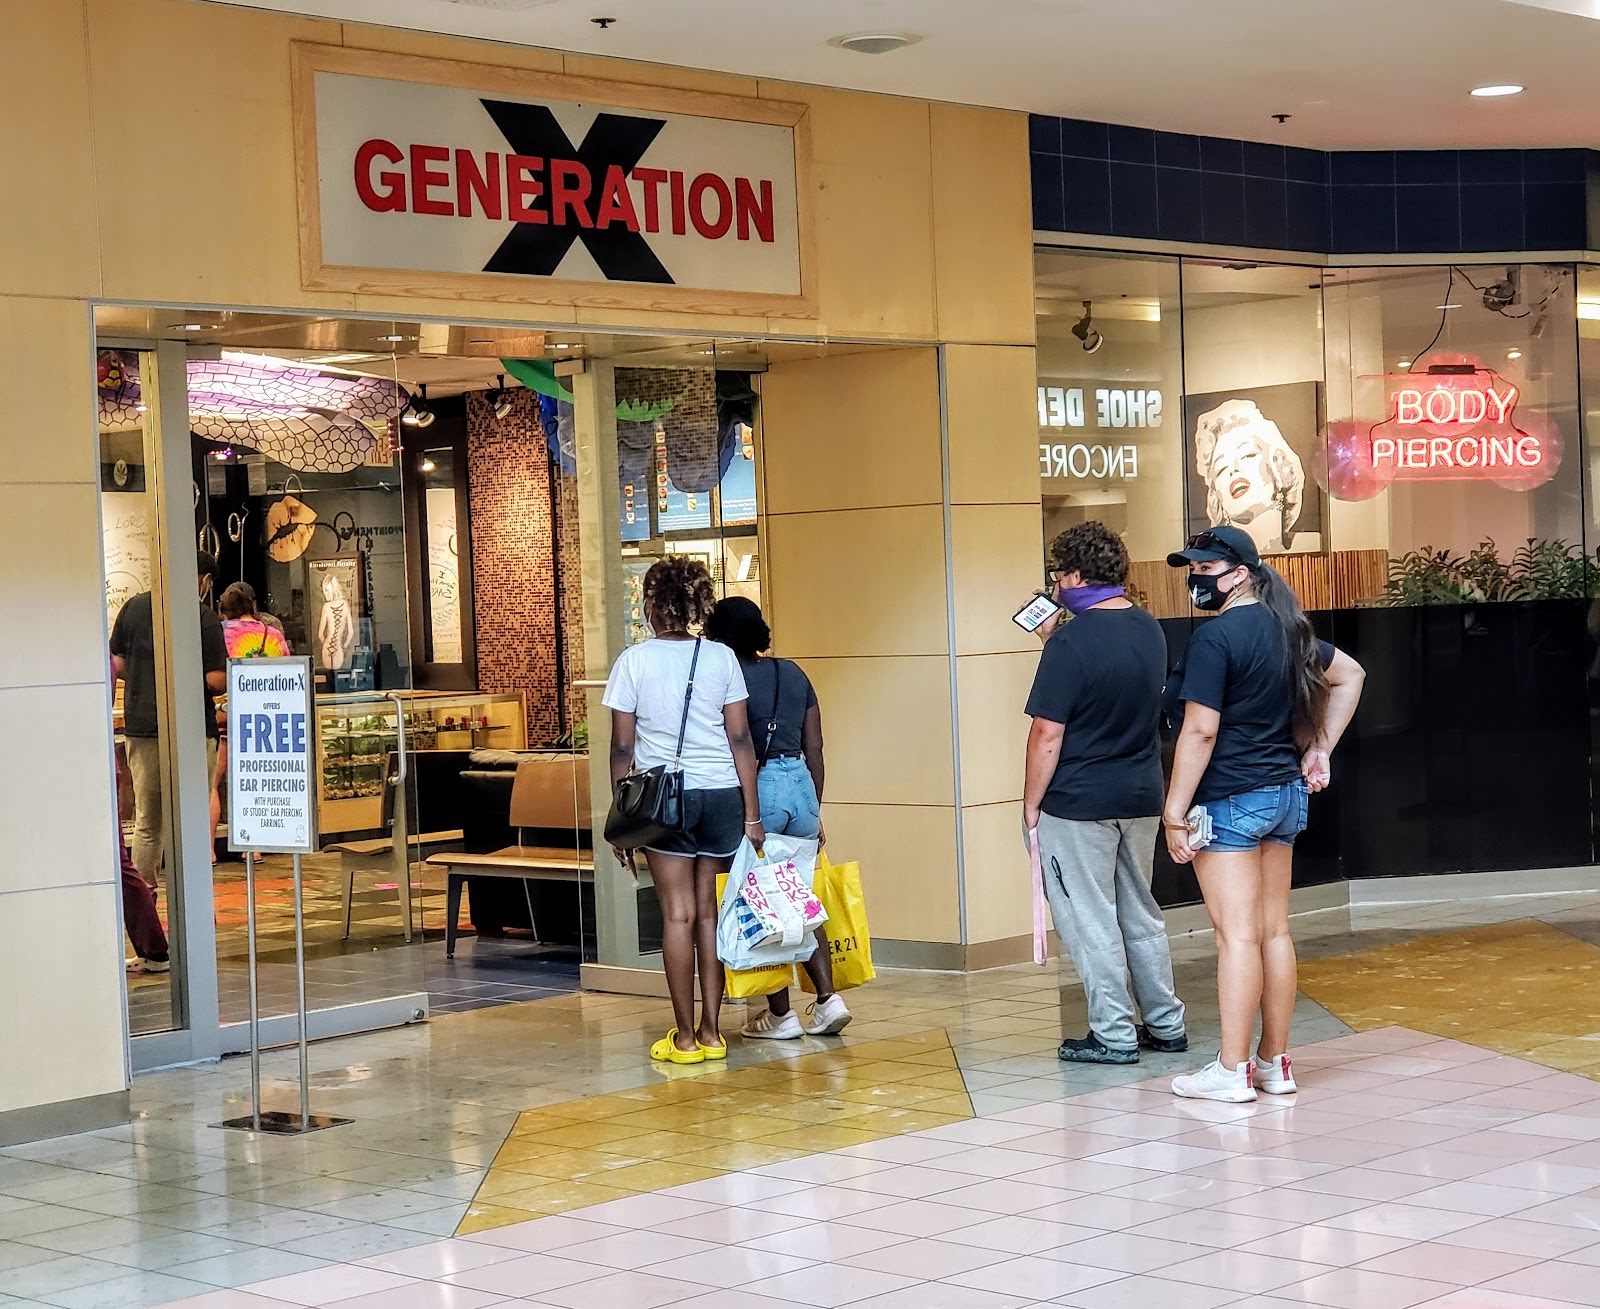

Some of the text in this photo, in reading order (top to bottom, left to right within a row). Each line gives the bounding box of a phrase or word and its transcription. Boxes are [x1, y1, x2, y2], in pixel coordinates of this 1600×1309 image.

[354, 98, 775, 285] GENERATION X
[1397, 387, 1517, 425] BODY
[1372, 436, 1542, 467] PIERCING
[240, 713, 306, 753] FREE
[240, 760, 306, 773] PROFESSIONAL
[240, 779, 306, 792] EAR PIERCING
[254, 797, 291, 806] WITH PURCHASE
[243, 808, 249, 817] OF
[271, 808, 279, 817] EAR
[281, 808, 302, 817] PIERCING
[844, 936, 857, 951] 21
